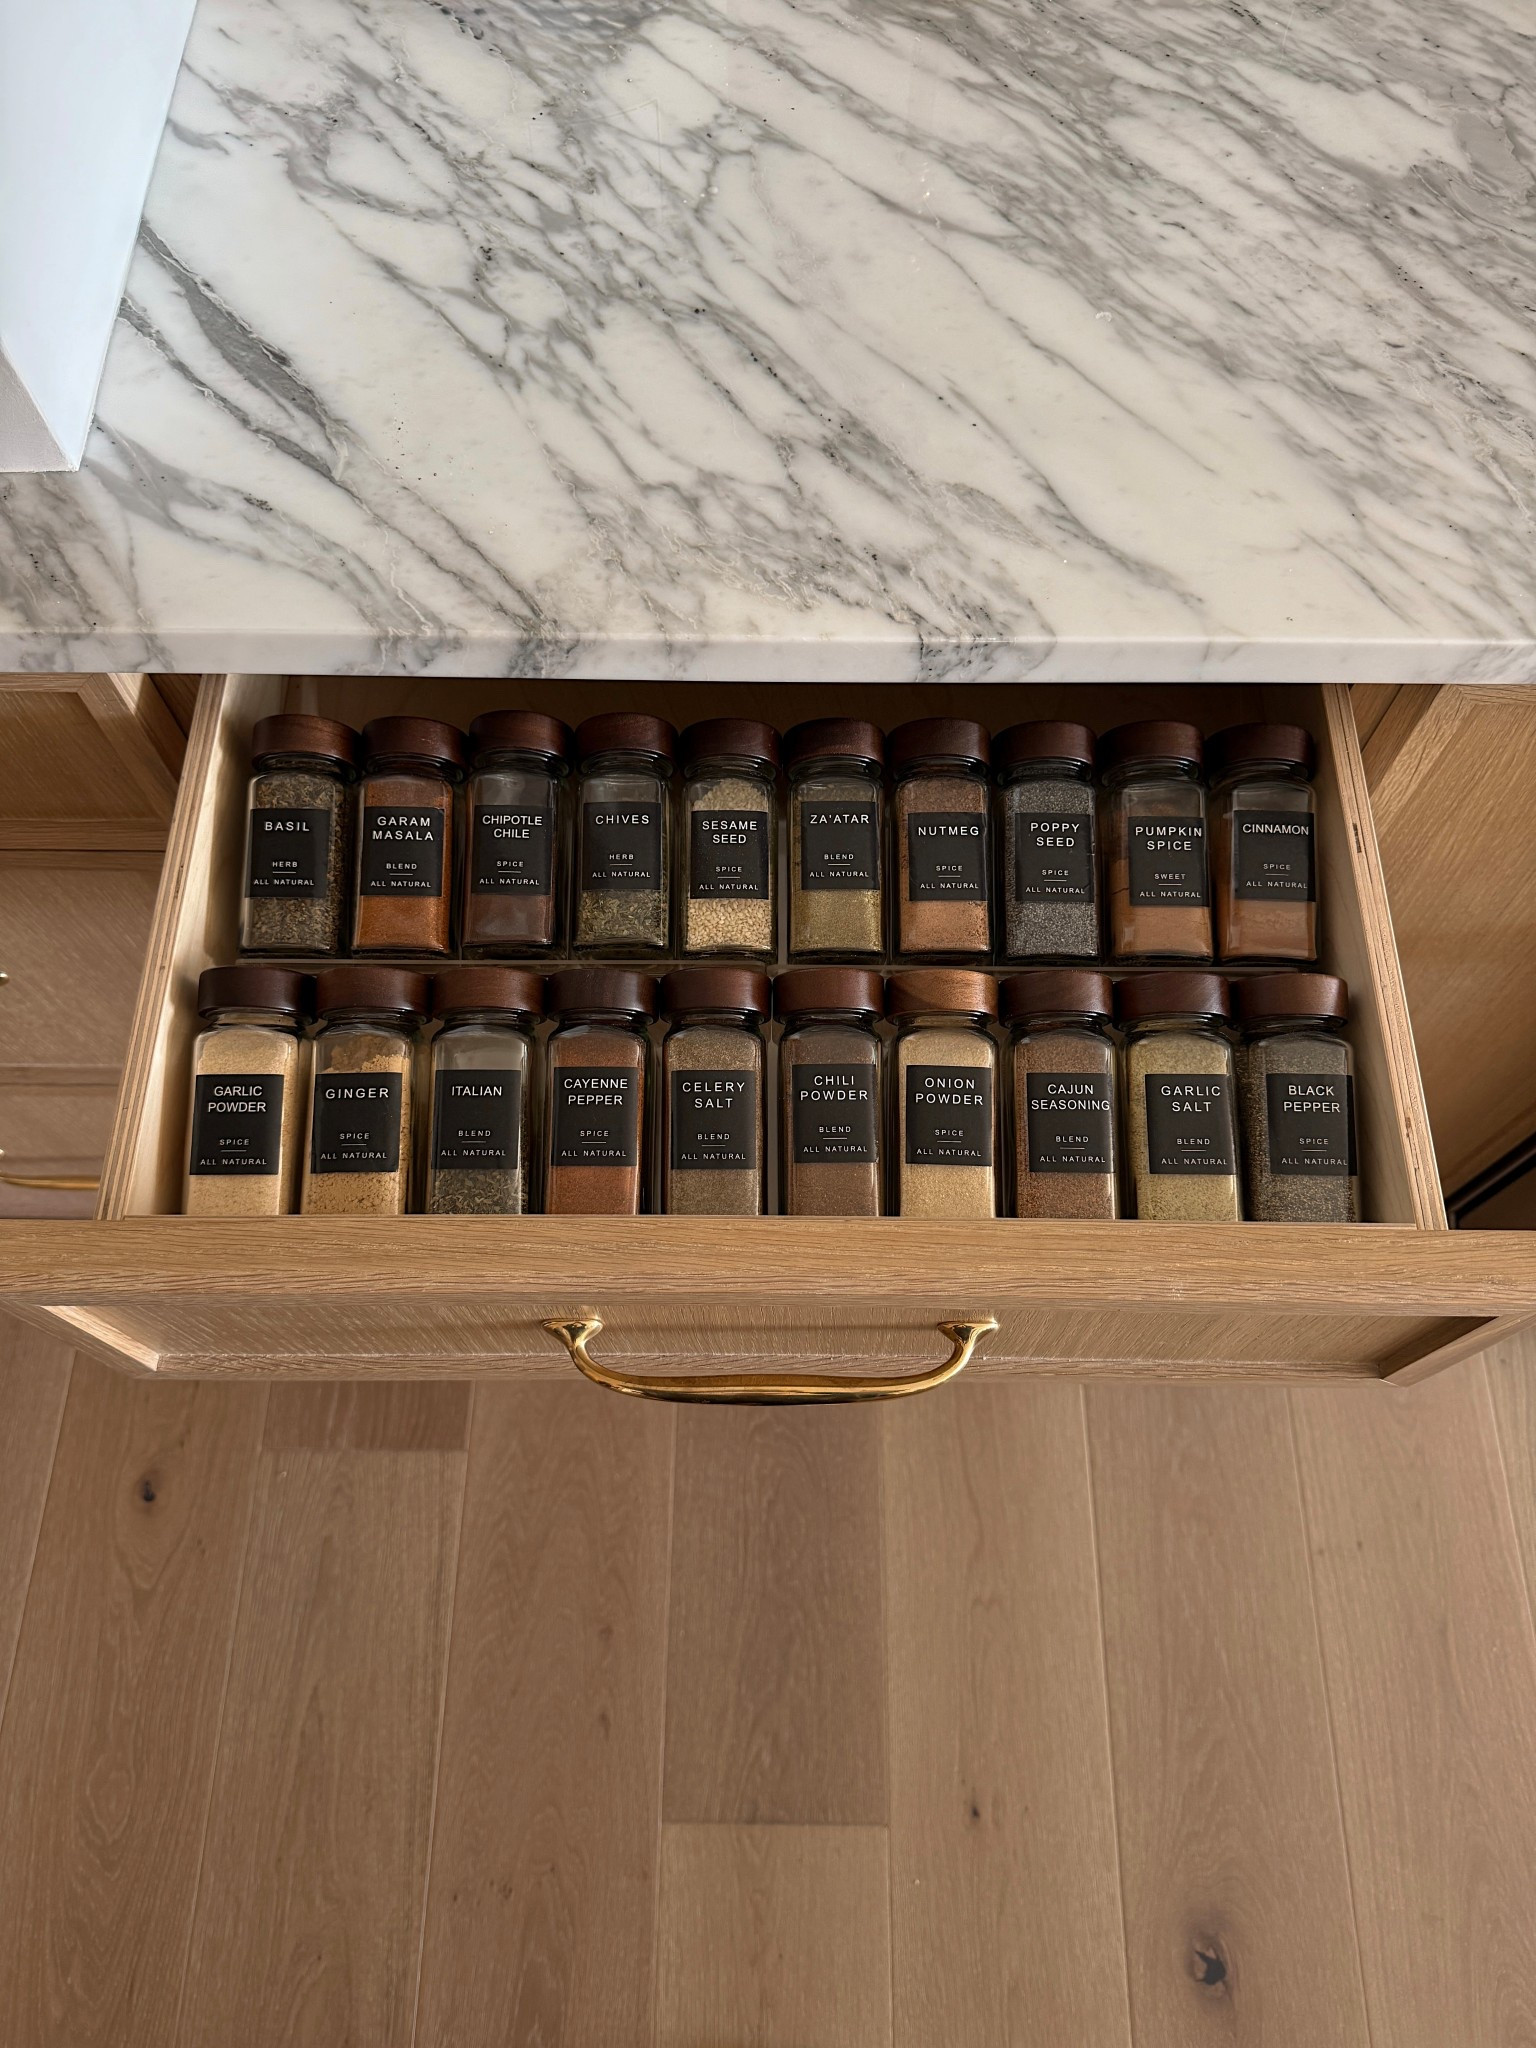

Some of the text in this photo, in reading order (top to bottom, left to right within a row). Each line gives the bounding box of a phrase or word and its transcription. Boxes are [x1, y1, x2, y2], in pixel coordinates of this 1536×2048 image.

[377, 816, 431, 827] GARAM
[482, 815, 543, 826] CHIPOTLE
[595, 814, 650, 825] CHIVES
[810, 814, 870, 824] ZA'ATAR
[265, 821, 310, 832] BASIL
[702, 820, 758, 831] SESAME
[918, 826, 979, 836] NUTMEG
[1030, 823, 1080, 833] POPPY
[1242, 823, 1309, 835] CINNAMON
[372, 830, 434, 841] MASALA
[493, 828, 530, 839] CHILE
[1135, 826, 1202, 837] PUMPKIN
[712, 834, 747, 844] SEED
[1036, 836, 1075, 847] SEED
[1147, 840, 1192, 851] SPICE
[499, 878, 540, 886] NATURAL
[1267, 881, 1308, 889] NATURAL
[564, 1078, 628, 1089] CAYENNE
[813, 1075, 854, 1086] CHILI
[925, 1077, 975, 1090] ONION
[214, 1086, 263, 1097] GARLIC
[325, 1087, 389, 1099] GINGER
[451, 1085, 503, 1097] ITALIAN
[682, 1082, 746, 1093] CELERY
[1047, 1084, 1094, 1095] CAJUN
[1160, 1085, 1221, 1097] GARLIC
[1288, 1085, 1335, 1096] BLACK
[568, 1094, 623, 1105] PEPPER
[800, 1090, 868, 1101] POWDER
[915, 1093, 983, 1106] POWDER
[207, 1102, 267, 1113] POWDER
[694, 1098, 733, 1109] SALT
[1031, 1099, 1110, 1111] SEASONING
[1171, 1101, 1212, 1112] SALT
[1283, 1102, 1340, 1113] PEPPER
[339, 1132, 370, 1140] SPICE
[458, 1129, 491, 1137] BLEND
[934, 1129, 964, 1137] SPICE
[219, 1138, 250, 1146] SPICE
[1055, 1135, 1089, 1143] BLEND
[938, 1149, 981, 1157] NATURAL
[1281, 1157, 1348, 1166] ALL NATURAL
